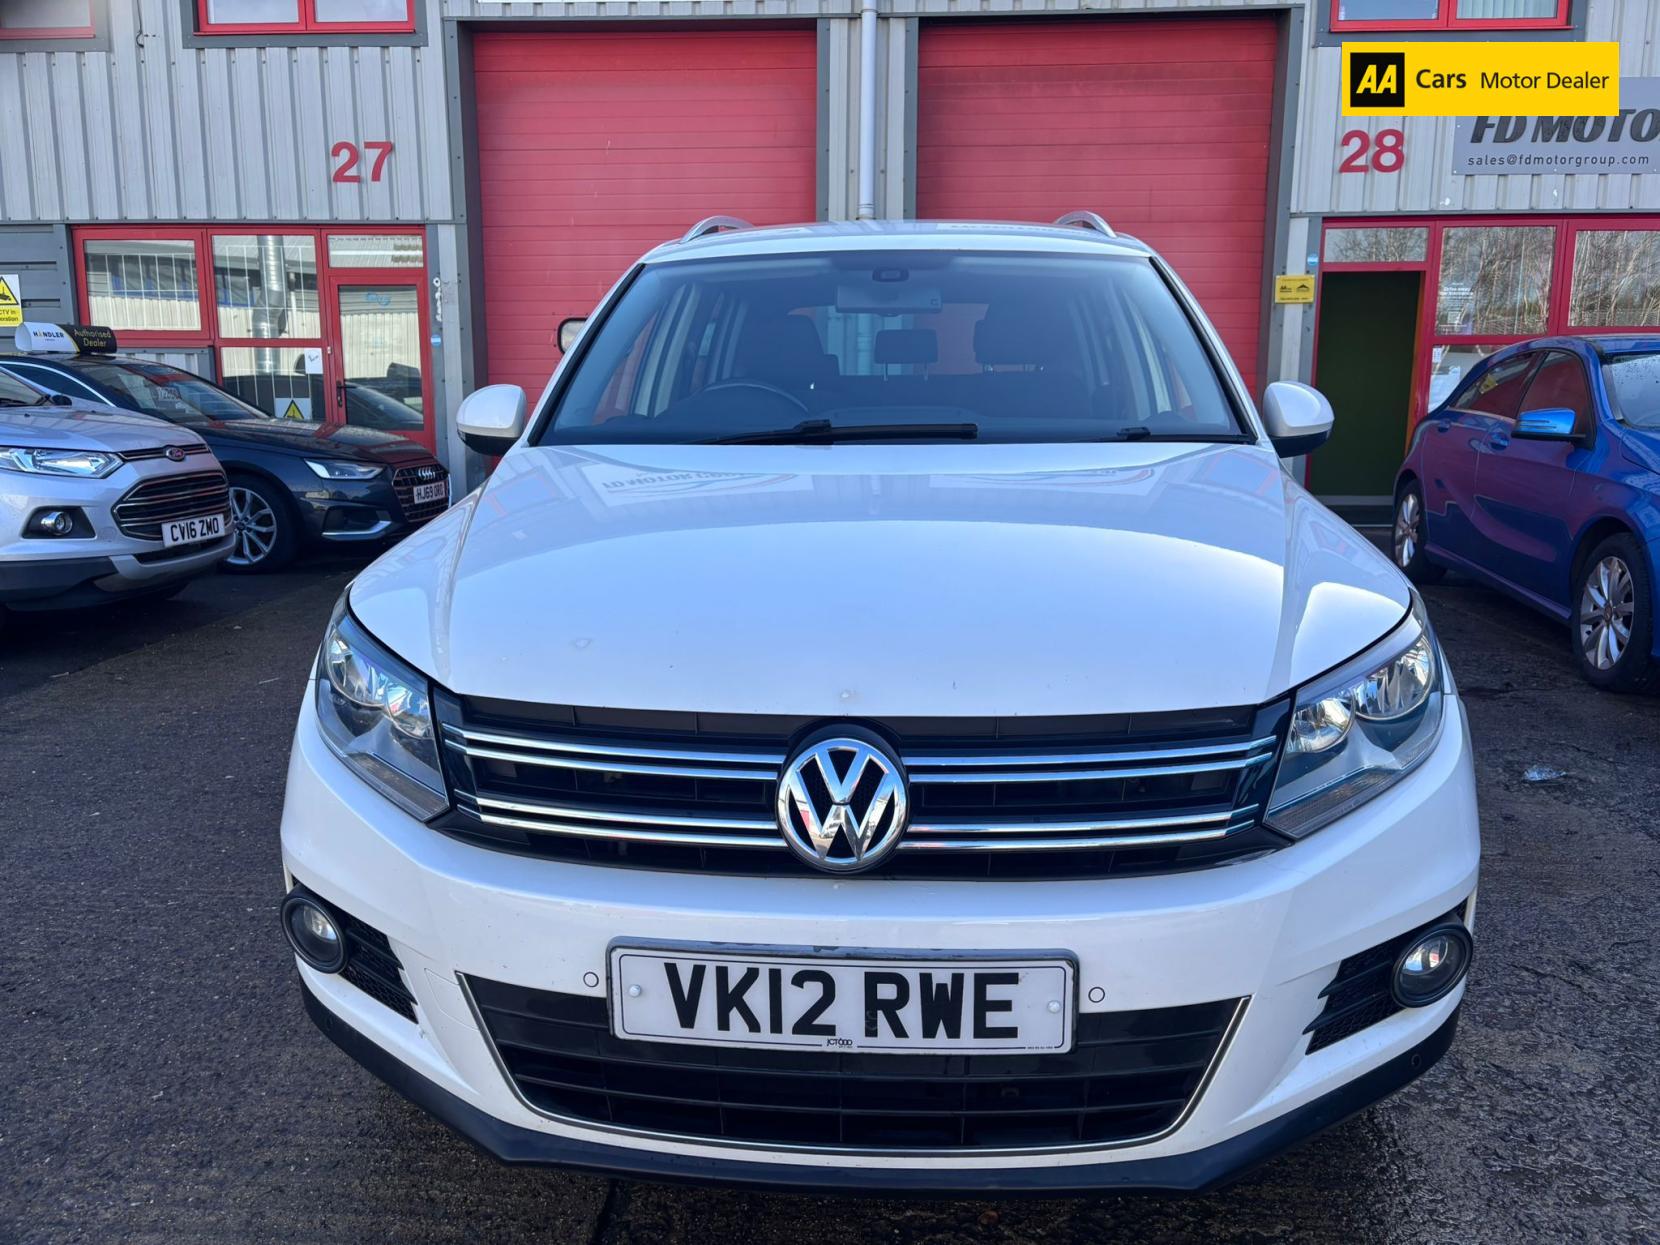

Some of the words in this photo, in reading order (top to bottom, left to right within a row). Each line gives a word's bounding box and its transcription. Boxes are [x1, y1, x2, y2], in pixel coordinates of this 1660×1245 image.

[1470, 115, 1527, 143] FD
[1531, 108, 1660, 143] MOTO
[331, 141, 393, 183] 27
[1339, 128, 1405, 174] 28
[1467, 154, 1650, 167] sales@fdmotorgroup.com
[74, 328, 112, 338] Authorised
[83, 337, 107, 347] Dealer
[170, 521, 197, 542] CV16
[199, 517, 220, 537] ZMO
[663, 962, 837, 1036] VK12
[864, 971, 1019, 1040] RWE
